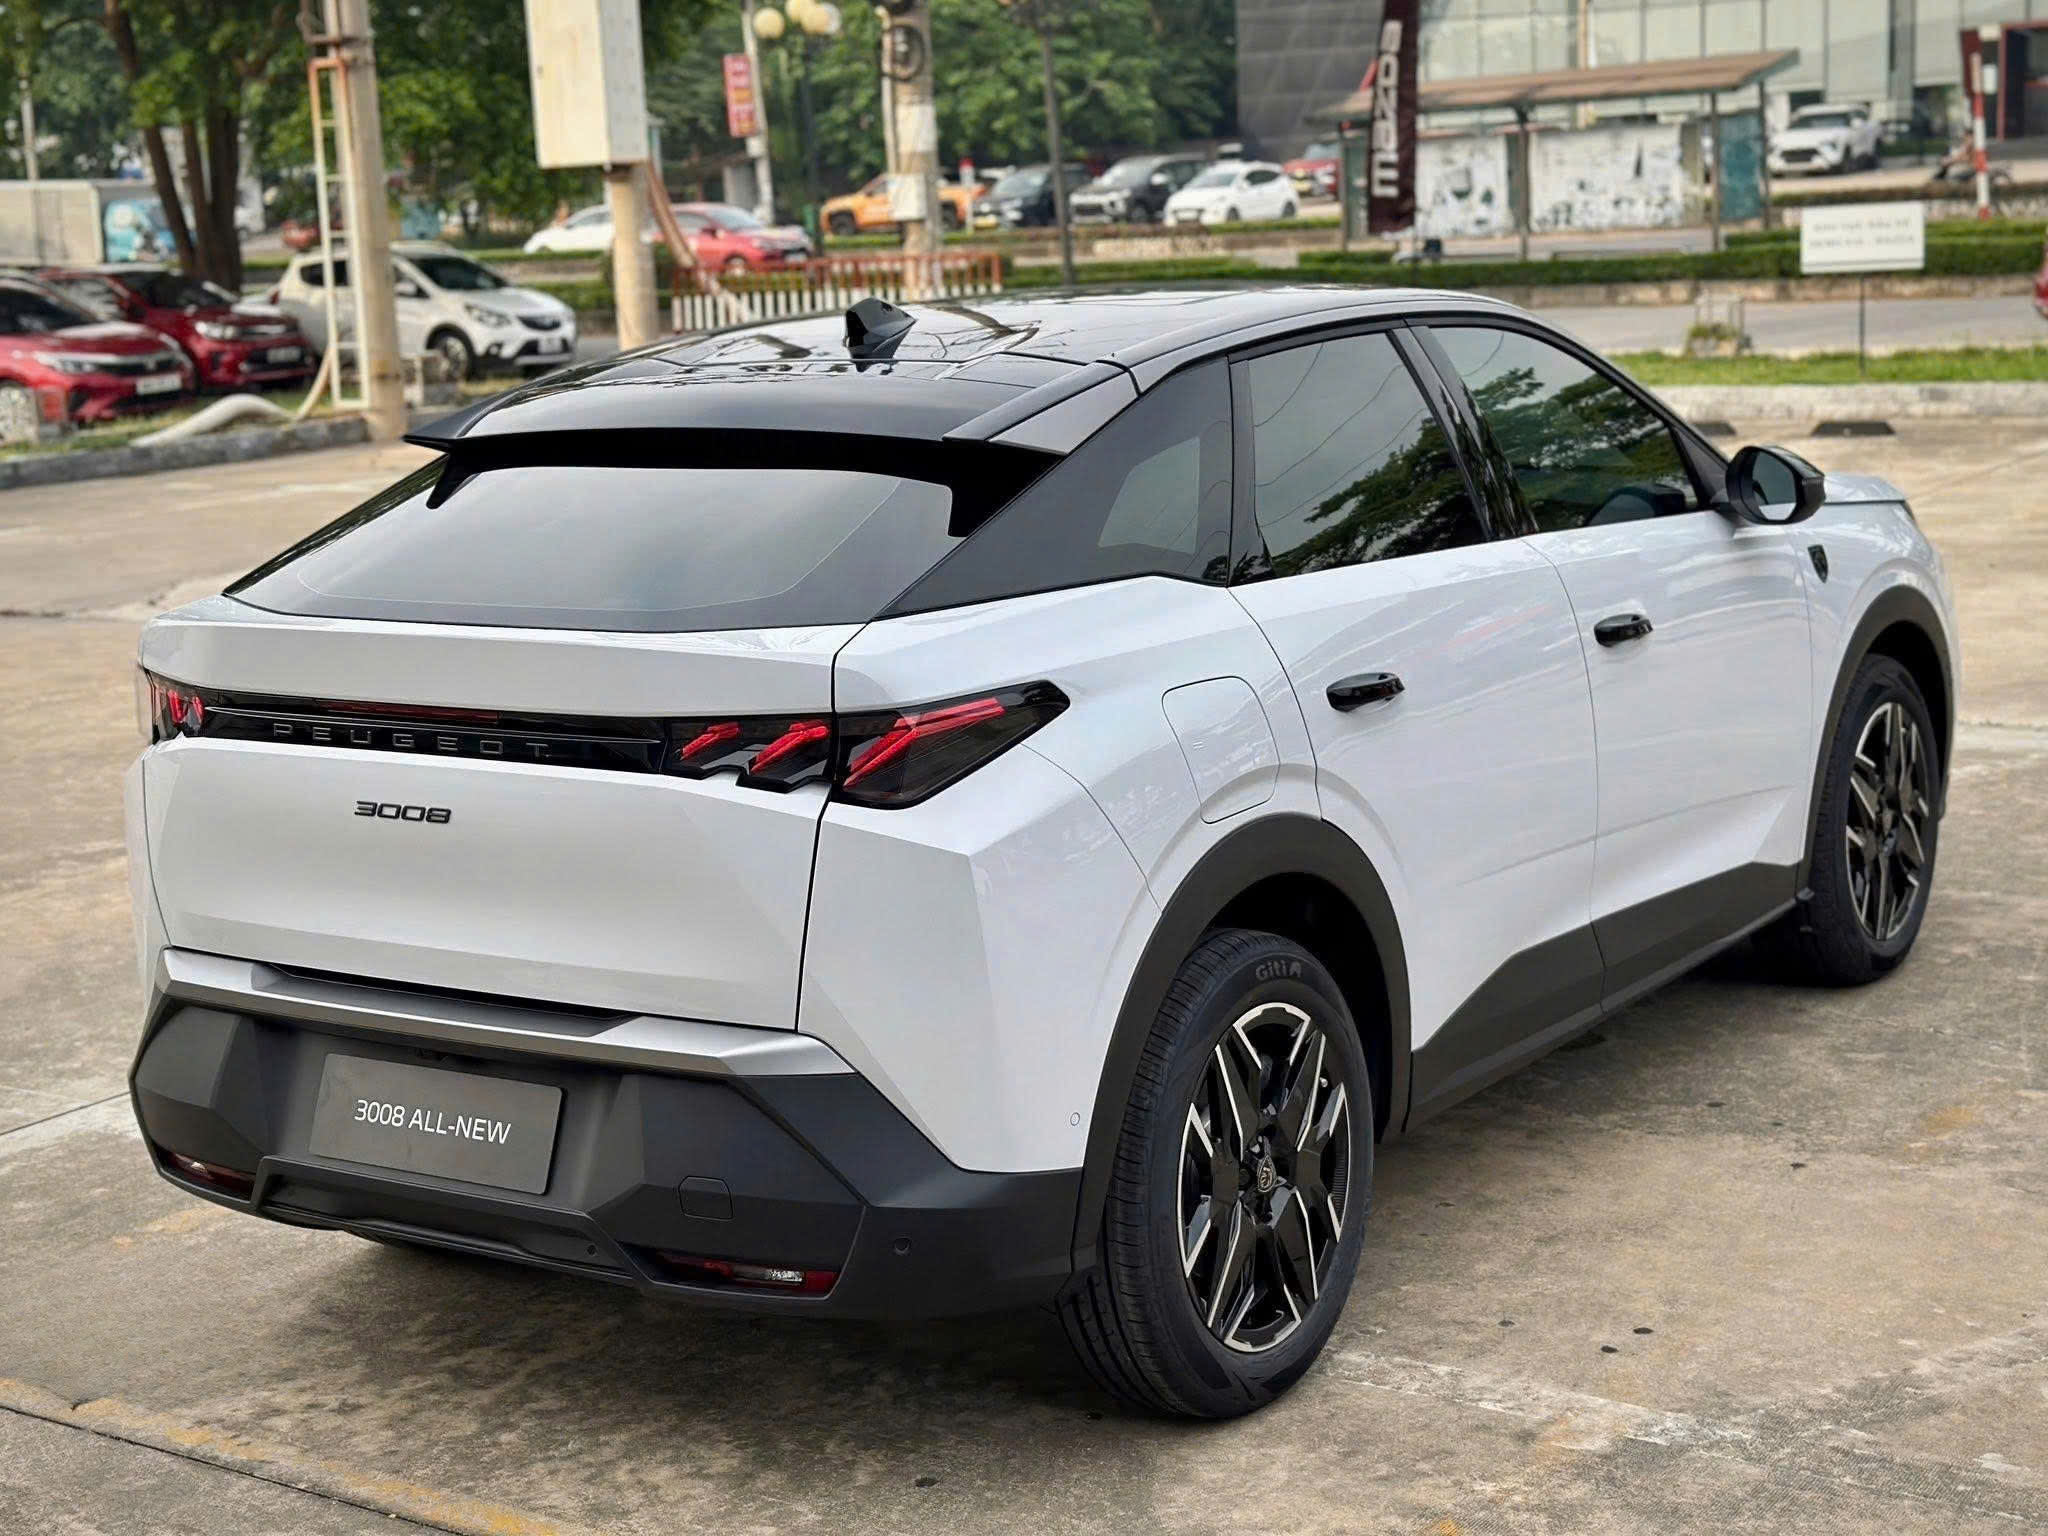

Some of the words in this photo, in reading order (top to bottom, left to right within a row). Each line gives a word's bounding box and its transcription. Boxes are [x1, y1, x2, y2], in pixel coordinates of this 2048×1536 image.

[273, 722, 549, 758] PEUGEOT
[353, 800, 452, 824] 3008
[353, 1099, 406, 1128] 3008
[408, 1108, 512, 1145] ALL-NEW
